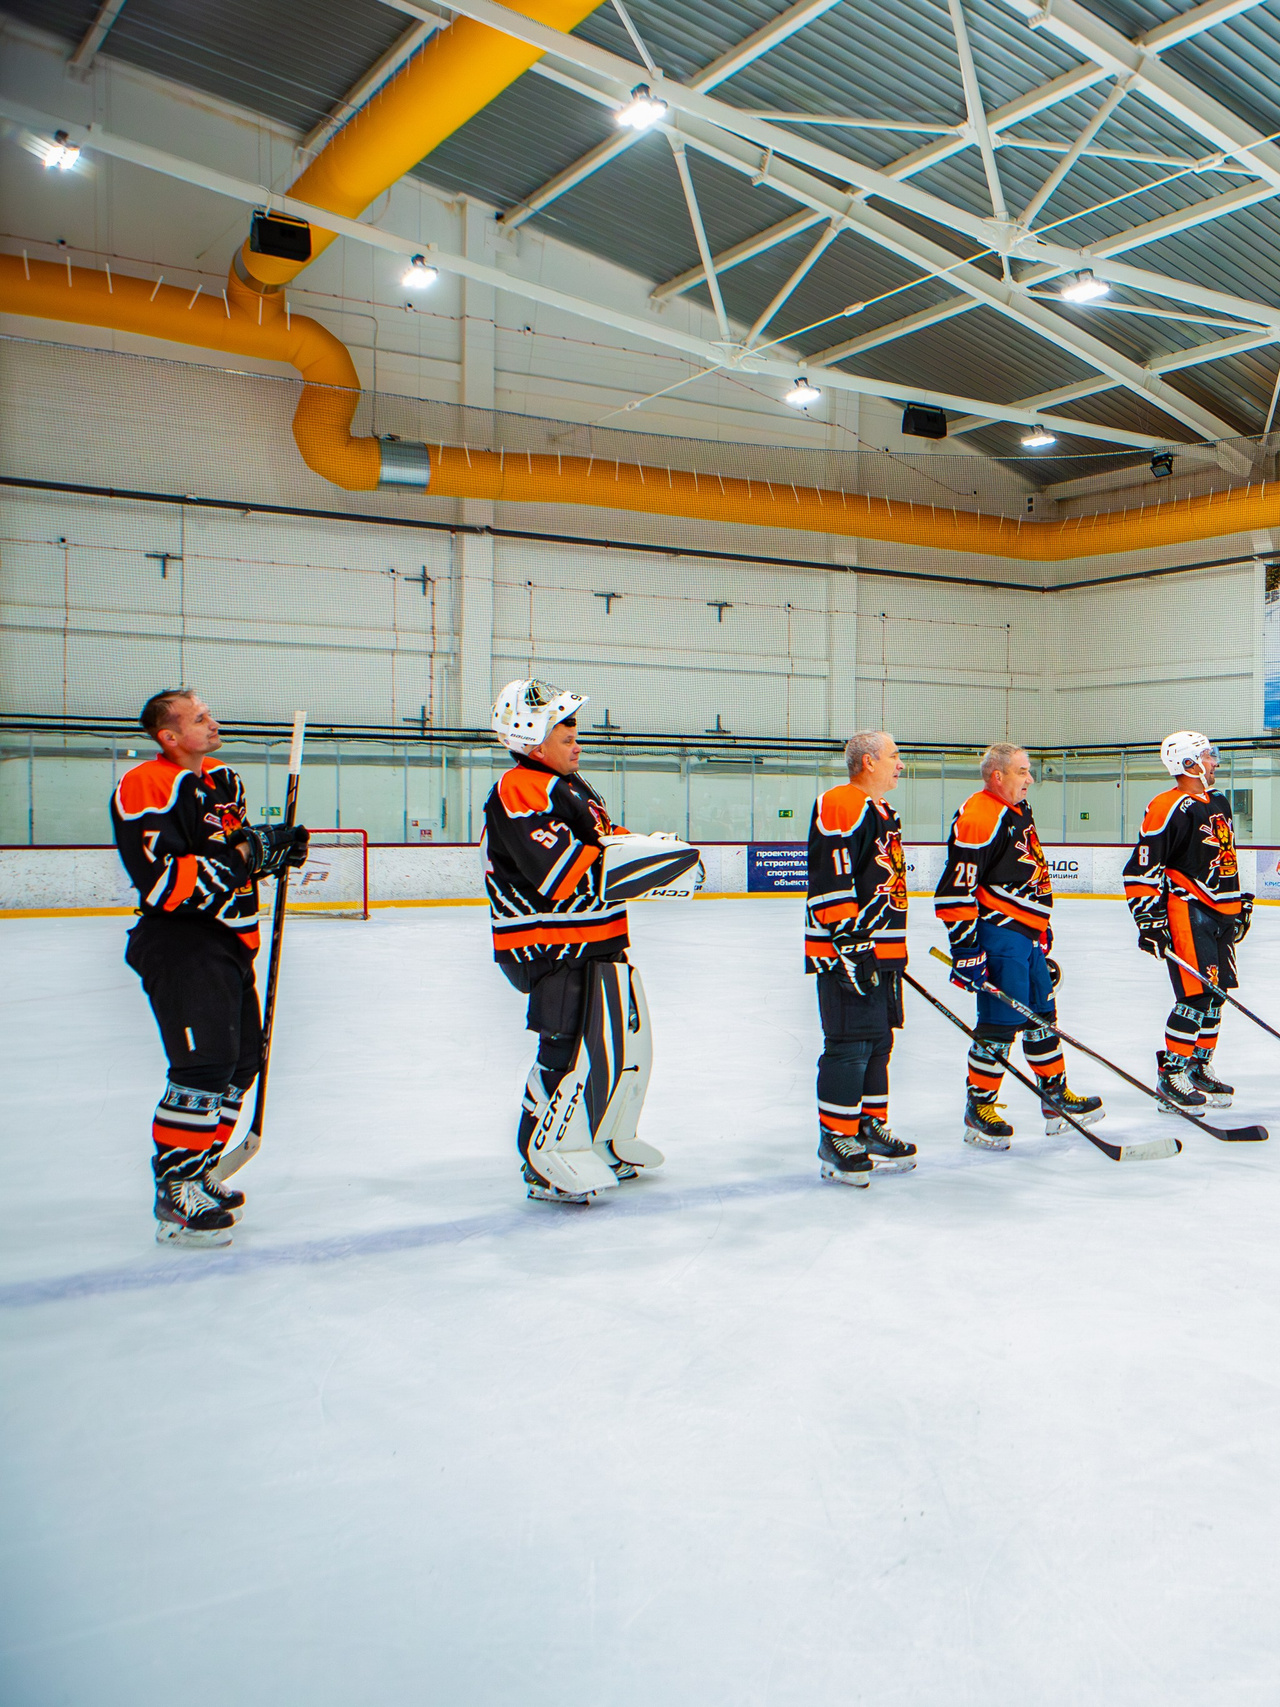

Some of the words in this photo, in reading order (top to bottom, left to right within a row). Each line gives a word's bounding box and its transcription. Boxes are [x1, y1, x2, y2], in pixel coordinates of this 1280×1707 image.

[954, 862, 978, 887] 28
[1138, 846, 1150, 867] 8
[534, 1089, 563, 1151] CCM
[556, 1082, 583, 1141] CCM
